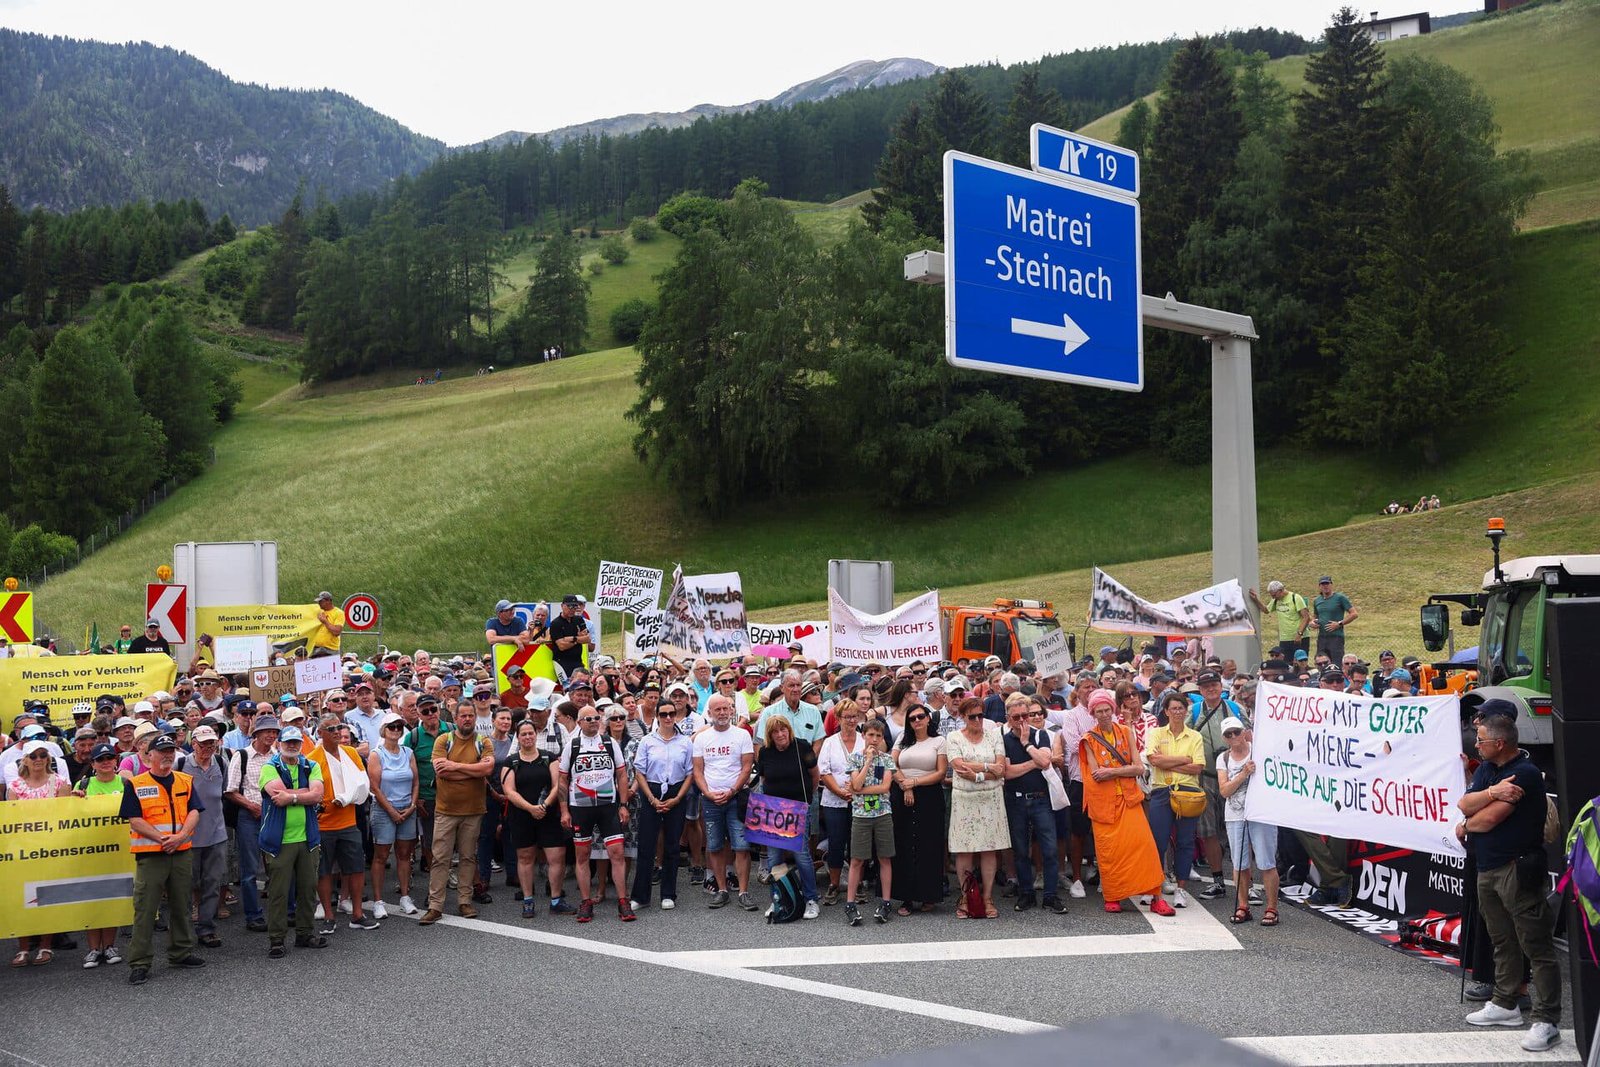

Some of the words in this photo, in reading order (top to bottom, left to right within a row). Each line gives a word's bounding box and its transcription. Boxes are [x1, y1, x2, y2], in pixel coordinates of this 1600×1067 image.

[1095, 152, 1117, 181] 19
[1006, 194, 1092, 247] Matrei
[985, 245, 1112, 301] -Steinach
[601, 563, 662, 580] ZULAUFSTRECKEN?
[601, 574, 654, 589] DEUTSCHLAND
[601, 585, 627, 596] LÜGT
[627, 588, 643, 597] SEIT
[597, 597, 632, 607] JAHREN!
[218, 614, 251, 622] Mensch
[352, 605, 371, 622] 80
[223, 624, 243, 632] NEIN
[834, 622, 846, 635] UNS
[636, 634, 659, 651] GEN
[703, 635, 741, 655] Kinder
[1036, 633, 1060, 651] PRIVAT
[834, 647, 875, 660] ERSTICKEN
[876, 648, 889, 660] IM
[890, 645, 939, 660] VERKEHR
[22, 670, 70, 680] Mensch
[74, 669, 92, 677] vor
[95, 665, 145, 676] Verkehr!
[271, 669, 295, 683] OMA
[30, 684, 58, 693] NEIN
[61, 684, 84, 692] zum
[87, 681, 139, 690] Fernpass-
[1267, 694, 1324, 725] SCHLUSS
[1369, 702, 1429, 734] GUTER
[1264, 756, 1309, 797] GÜTER
[1312, 774, 1338, 804] AUF
[0, 821, 53, 834] UFREI,
[58, 815, 130, 830] MAUTFRE
[751, 806, 800, 834] STOP!
[20, 843, 120, 860] Lebensraum
[1430, 852, 1465, 870] AUTOB
[1356, 859, 1408, 915] DEN
[1428, 870, 1464, 897] MATRE
